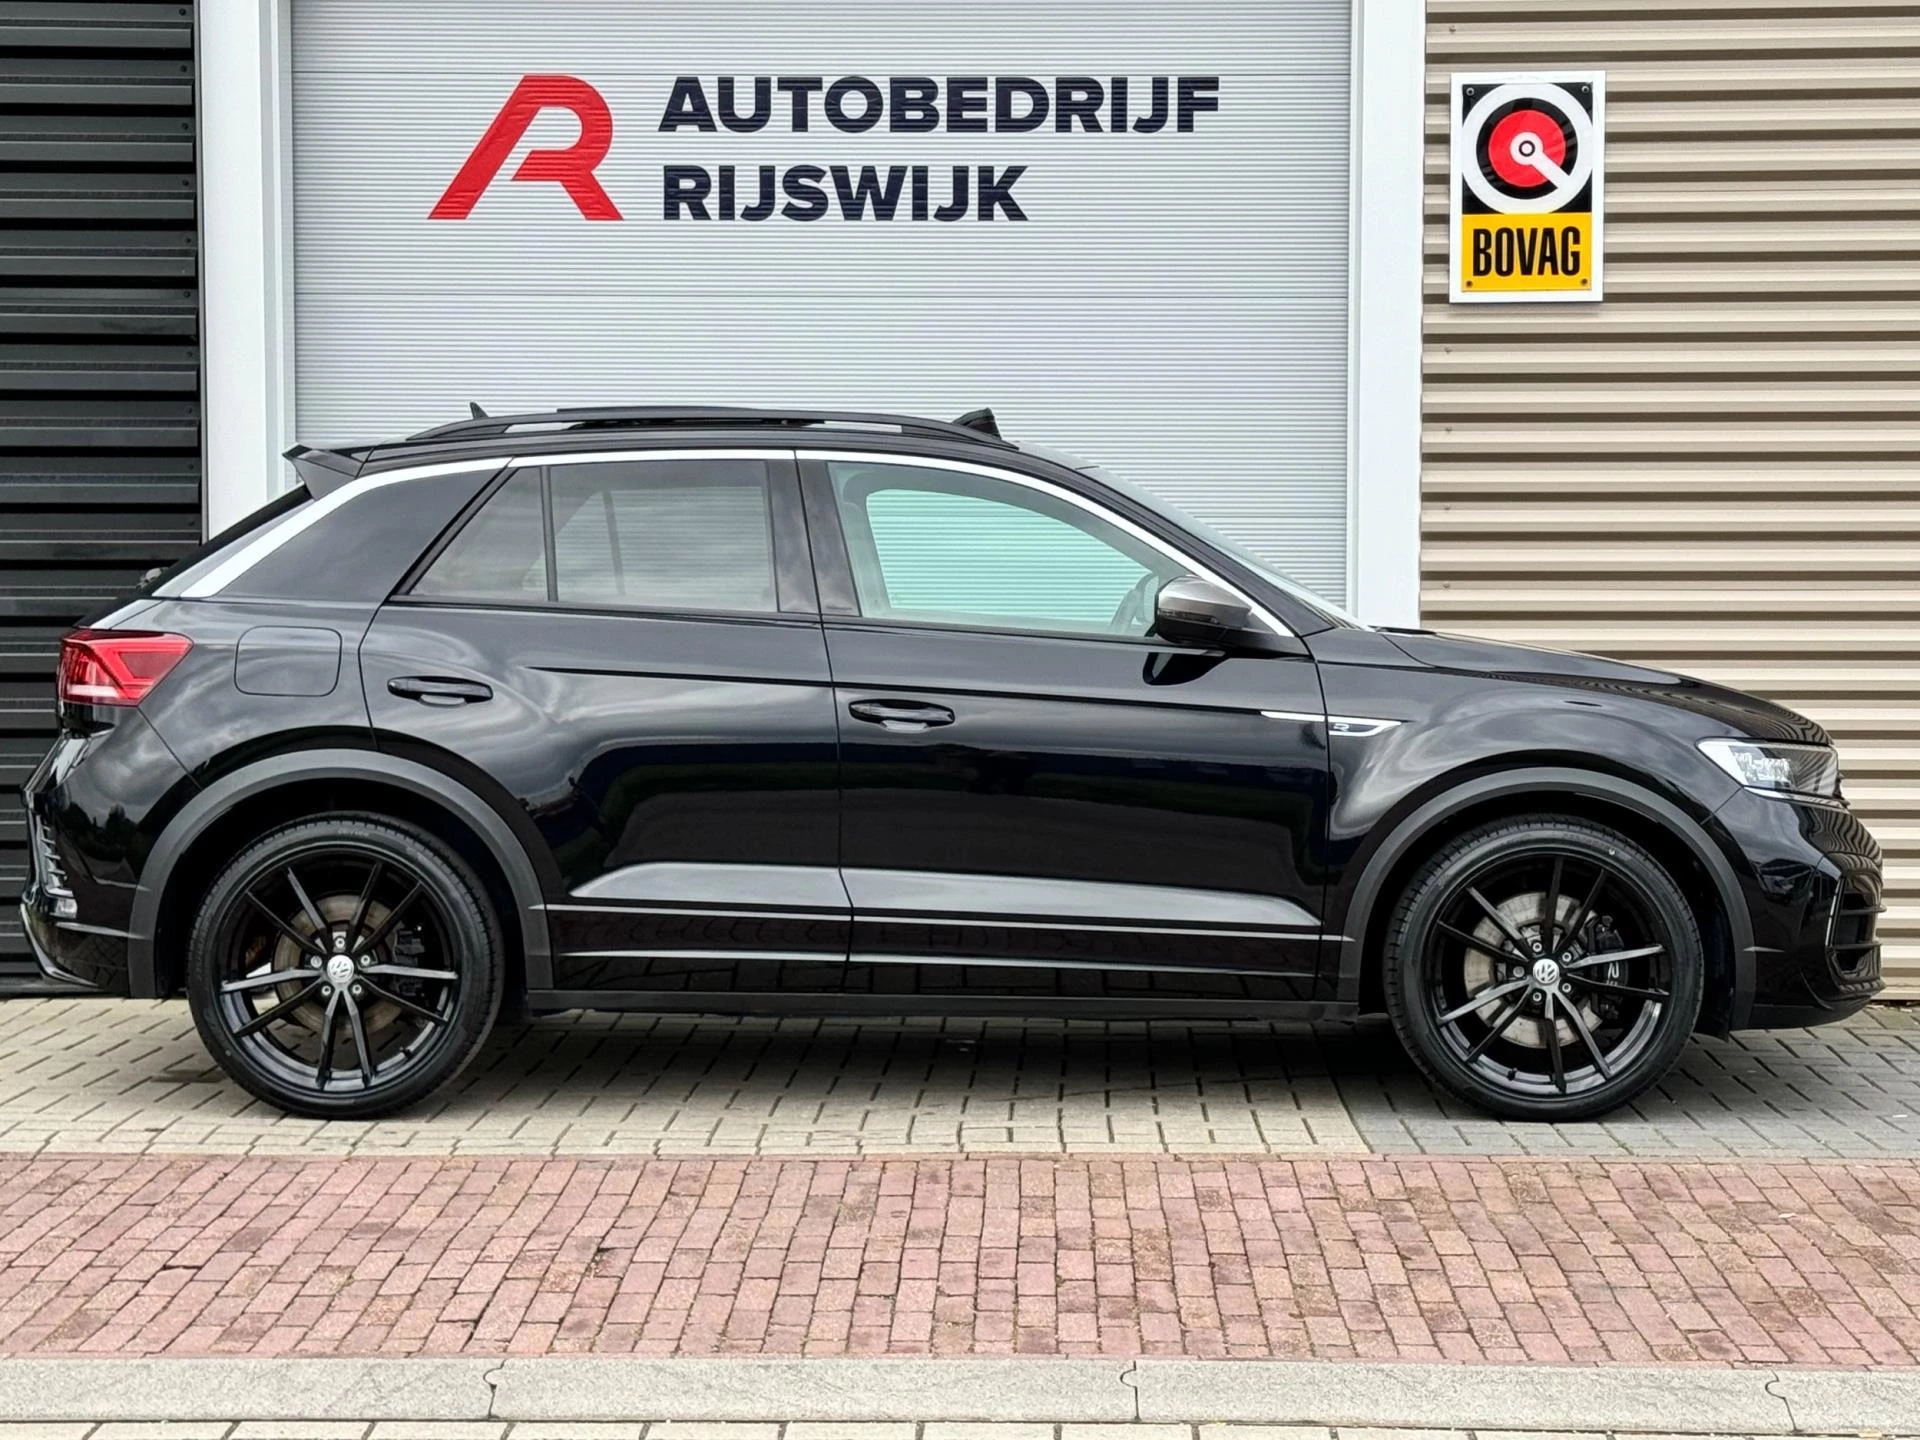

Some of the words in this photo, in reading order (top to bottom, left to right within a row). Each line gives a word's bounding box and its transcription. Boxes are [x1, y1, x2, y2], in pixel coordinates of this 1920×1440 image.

[658, 76, 1220, 134] AUTOBEDRIJF
[663, 164, 1029, 222] RIJSWIJK
[1472, 226, 1581, 277] BOVAG
